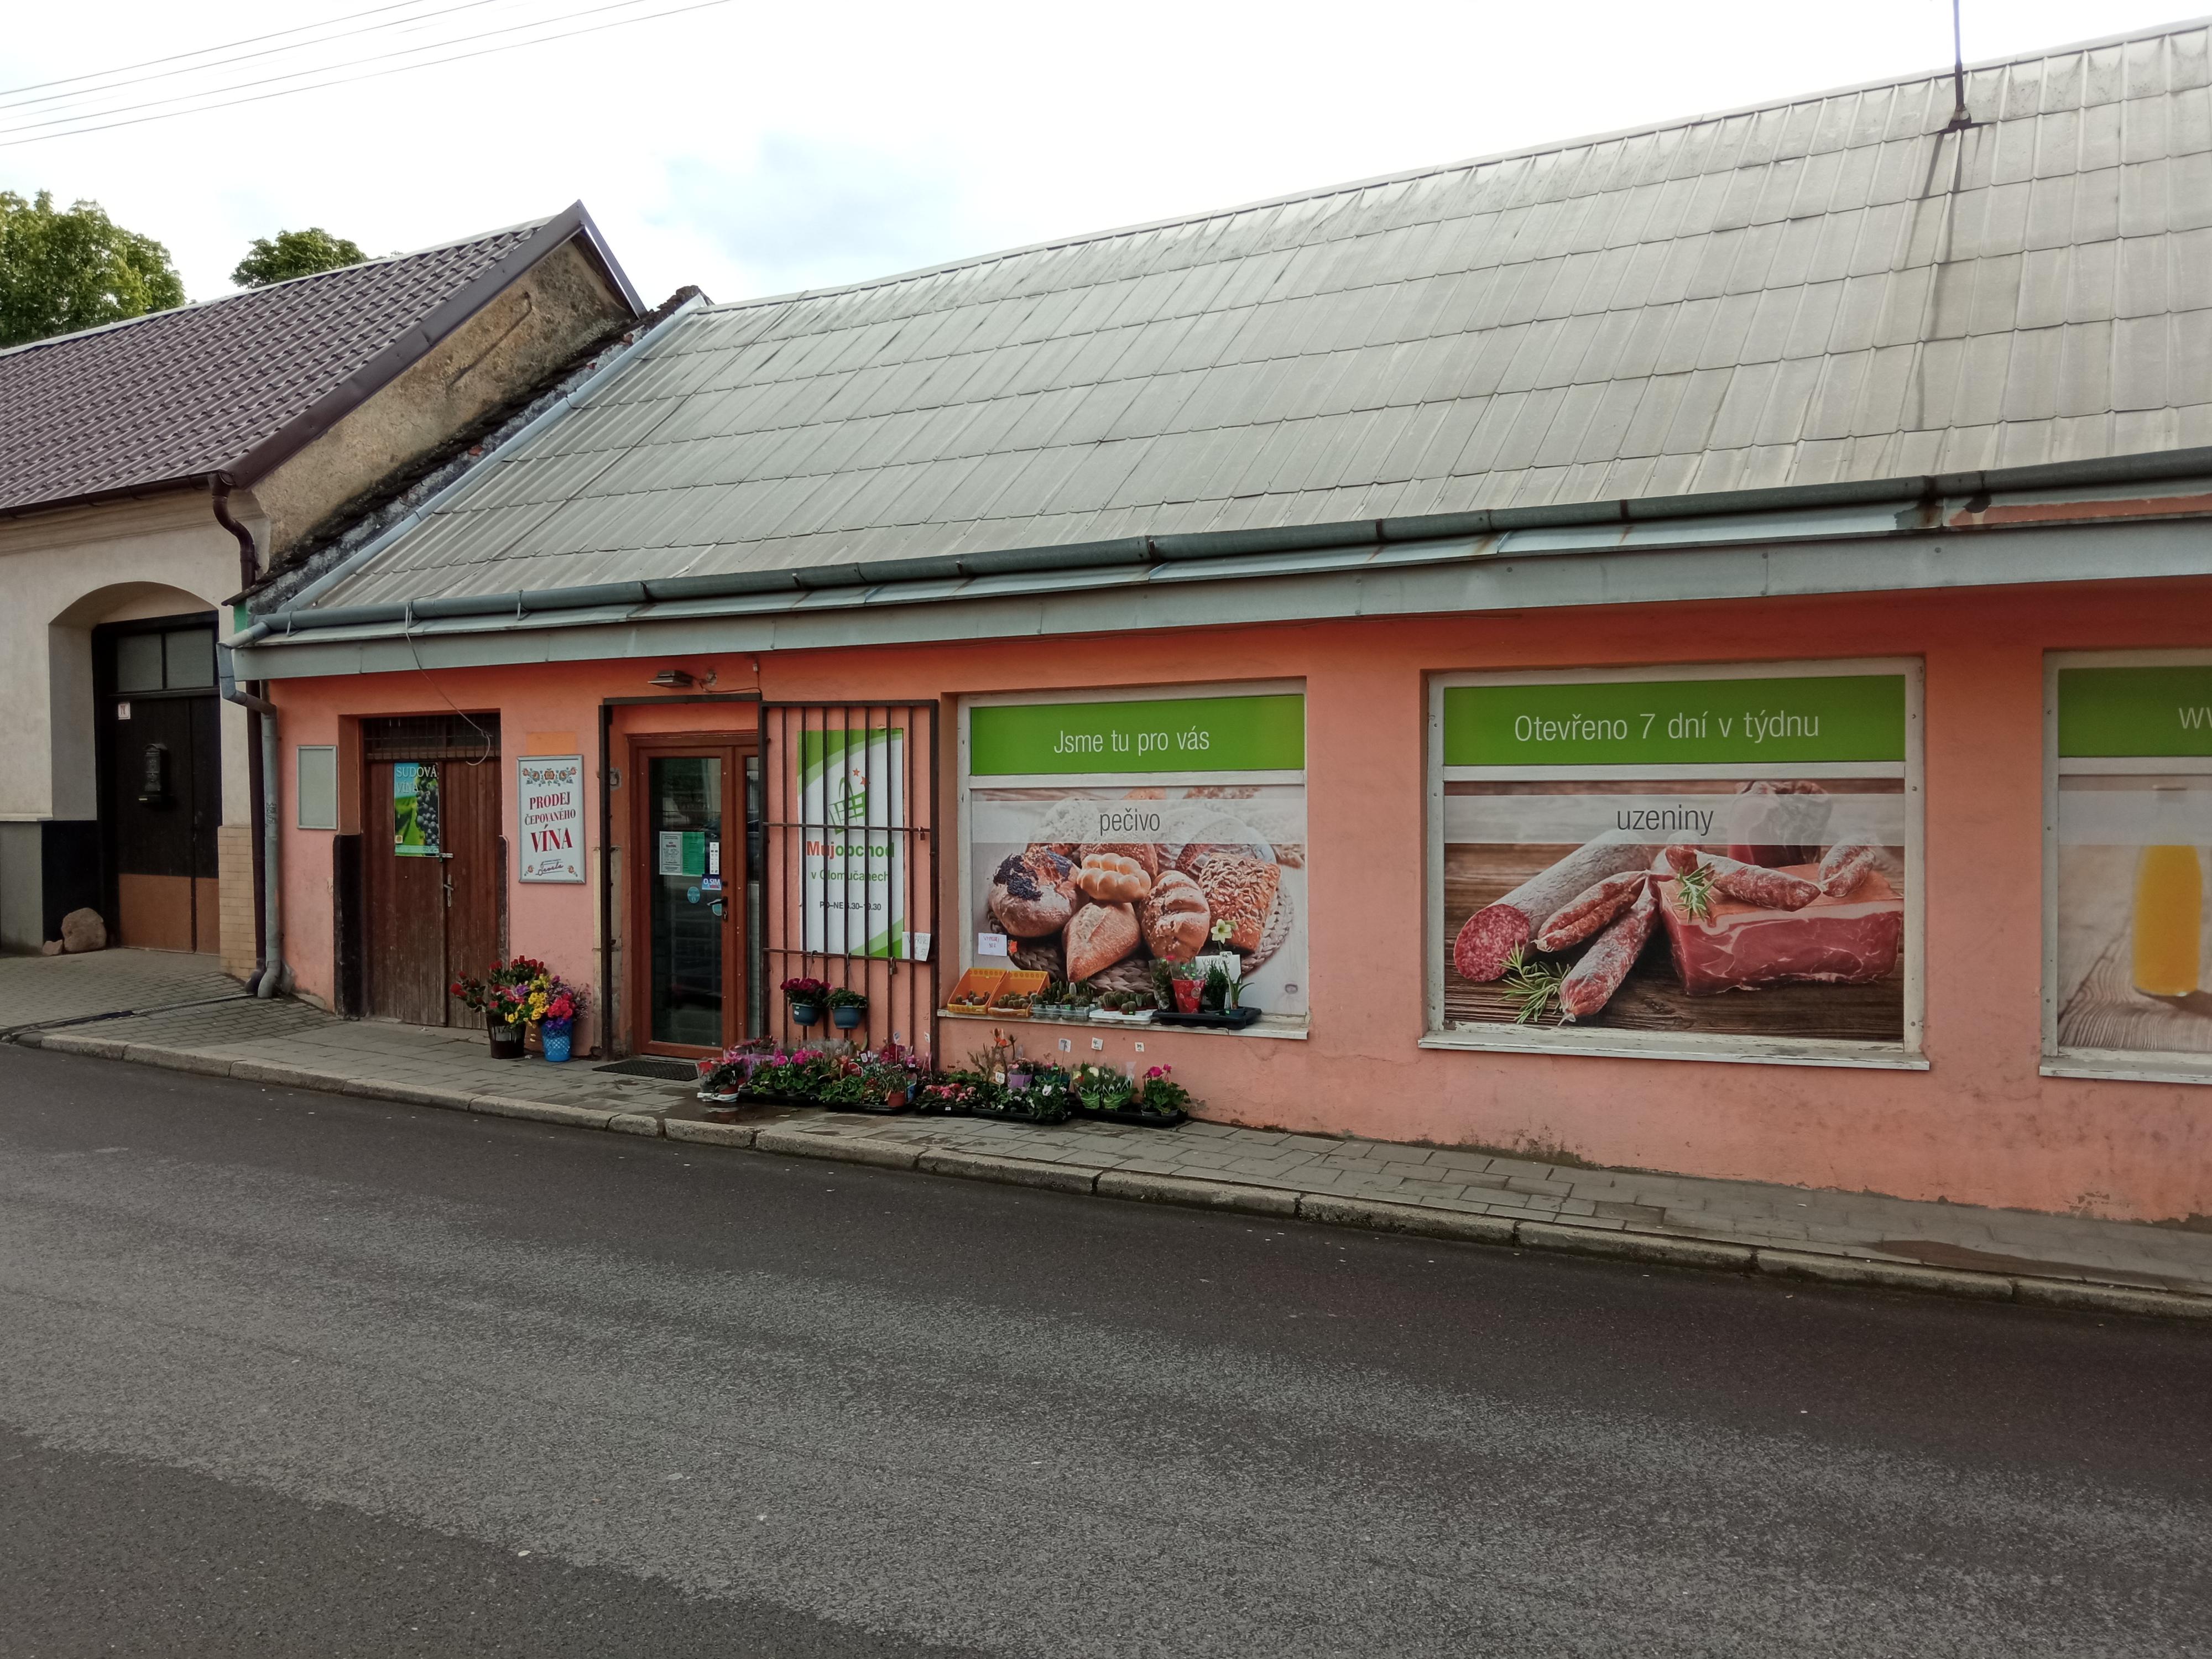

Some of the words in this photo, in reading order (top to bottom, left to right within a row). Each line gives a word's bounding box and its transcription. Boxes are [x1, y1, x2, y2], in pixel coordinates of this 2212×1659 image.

[1515, 713, 1627, 742] Otevřeno
[1640, 713, 1655, 739] 7
[1668, 711, 1708, 739] dní
[1718, 718, 1732, 738] v
[1743, 709, 1818, 743] týdnu
[1054, 731, 1103, 753] Jsme
[1111, 730, 1129, 752] tu
[1138, 732, 1168, 757] pro
[1176, 726, 1210, 750] vás
[396, 765, 437, 778] SUDOVÁ
[529, 791, 571, 810] PRODEJ
[524, 808, 576, 826] ČEPOVANÉHO
[1100, 807, 1160, 837] pečivo
[1617, 804, 1714, 836] uzeniny
[530, 823, 573, 853] VÍNA
[811, 872, 816, 880] v
